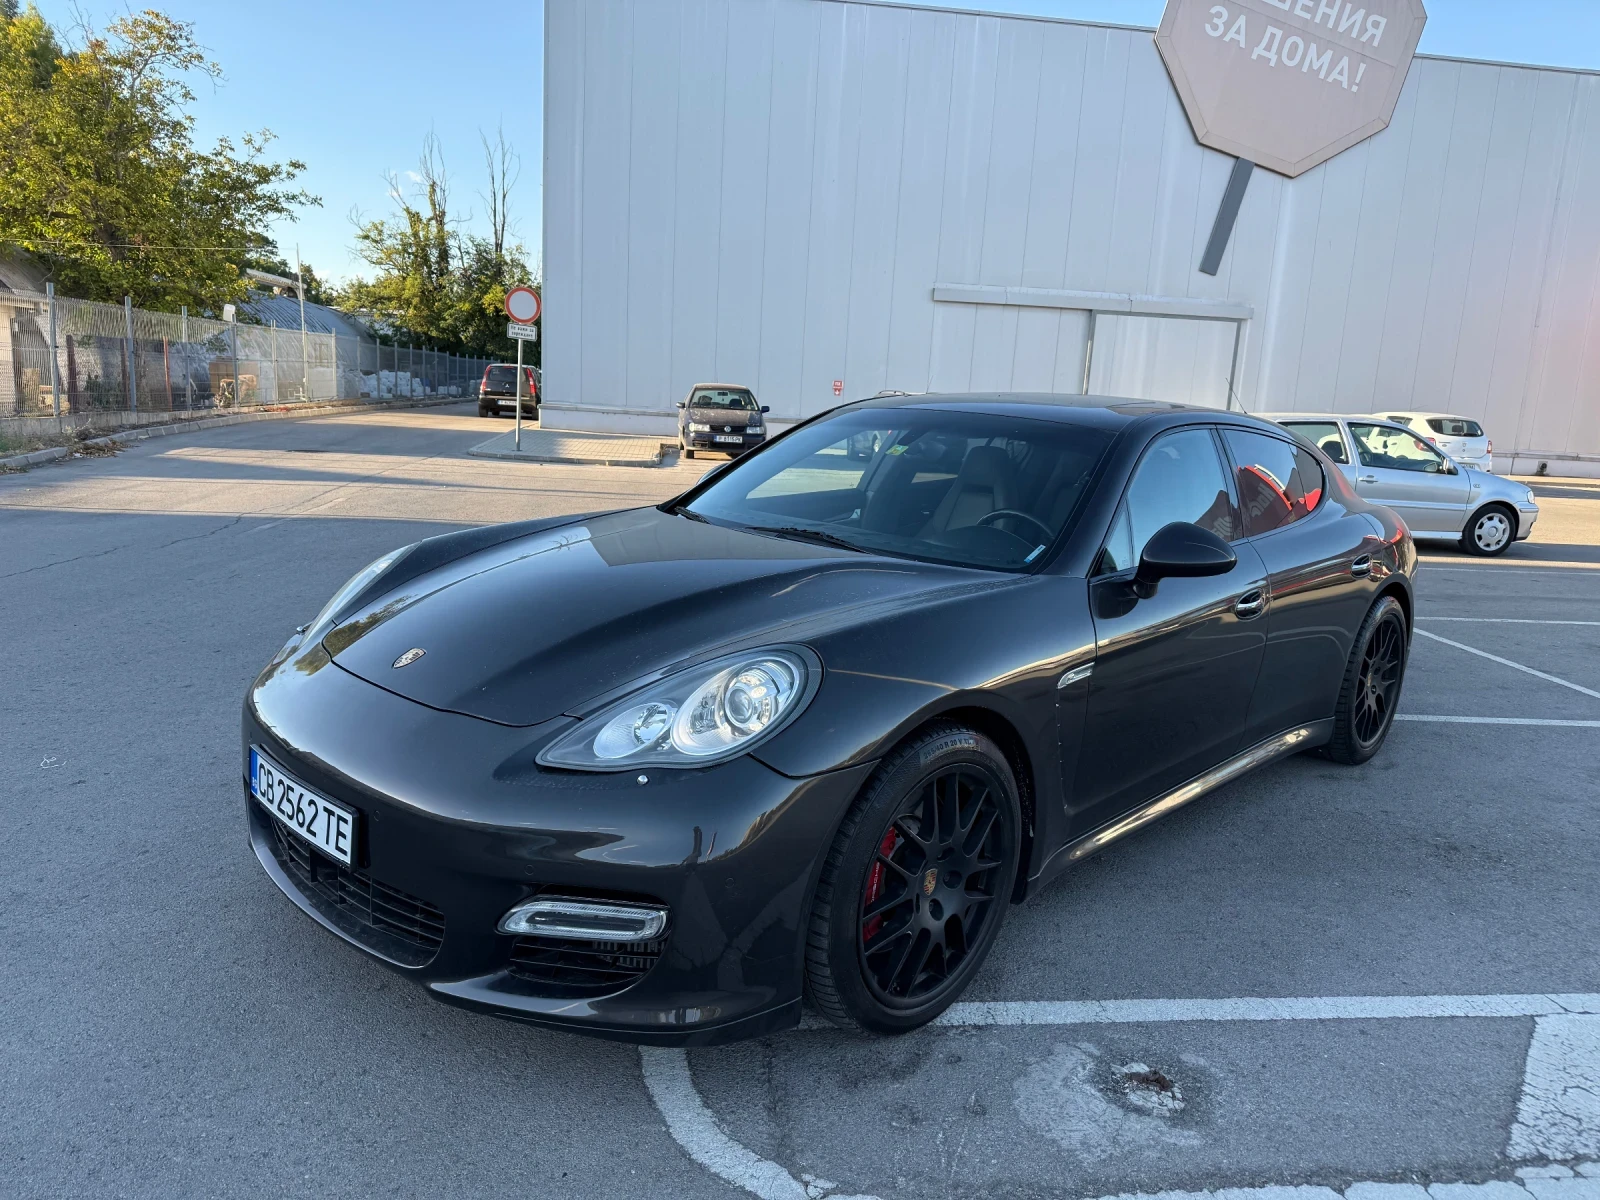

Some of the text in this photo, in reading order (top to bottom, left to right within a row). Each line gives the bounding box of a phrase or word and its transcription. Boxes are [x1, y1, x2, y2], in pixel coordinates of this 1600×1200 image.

[1204, 5, 1367, 93] ЗА ДОМА!
[1260, 0, 1388, 47] ЕНИЯ
[258, 762, 349, 857] CB 2562 TE
